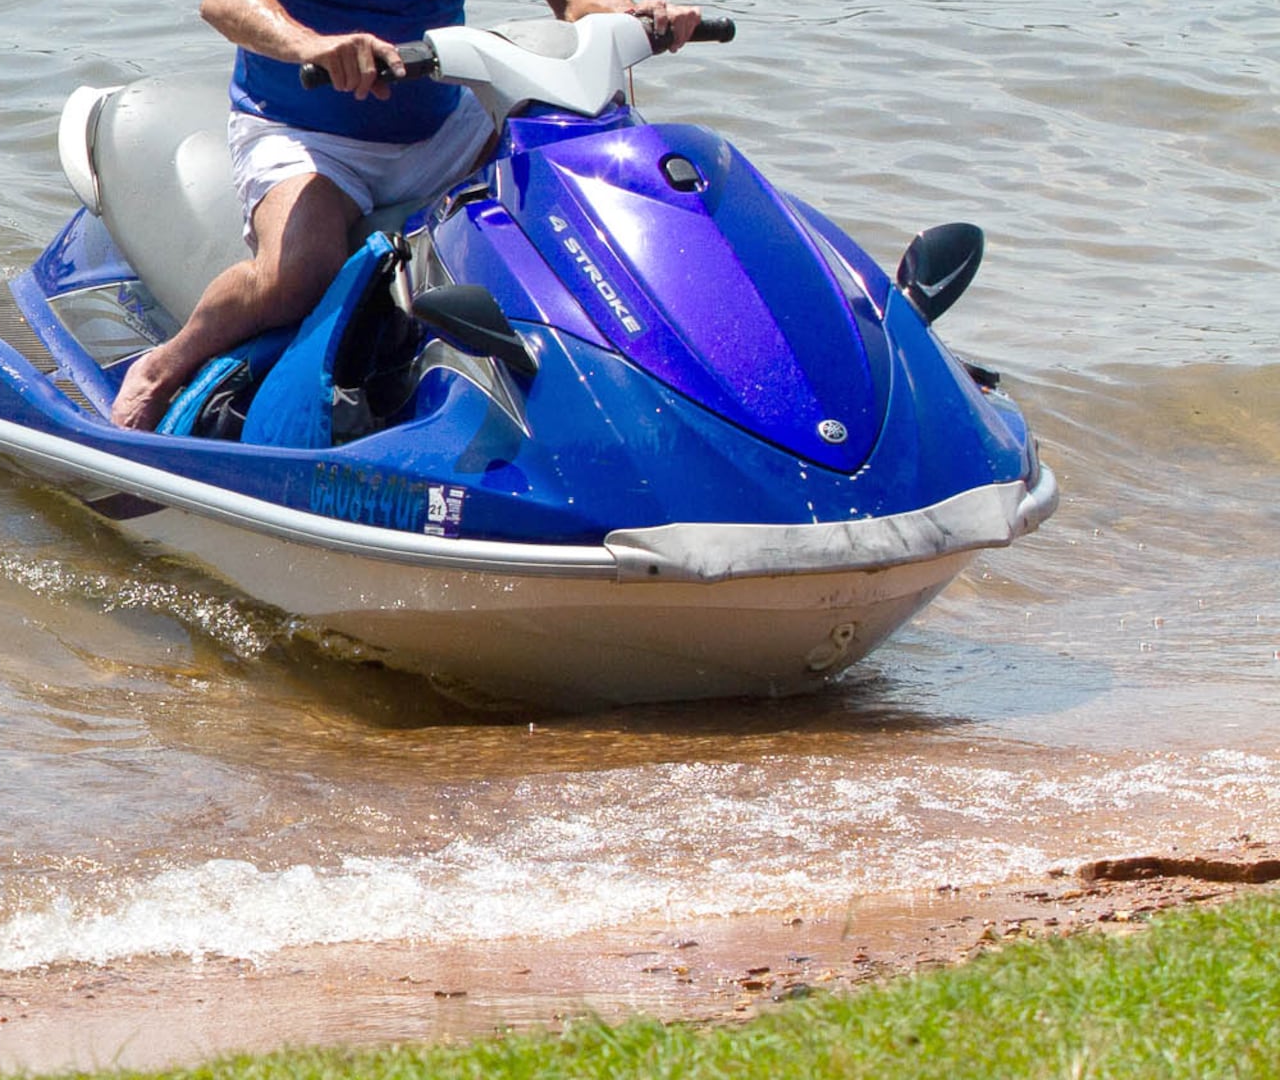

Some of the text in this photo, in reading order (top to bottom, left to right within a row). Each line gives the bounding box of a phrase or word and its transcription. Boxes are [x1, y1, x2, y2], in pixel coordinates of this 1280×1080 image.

[548, 215, 641, 334] 4 STROKE
[429, 504, 442, 516] 21
